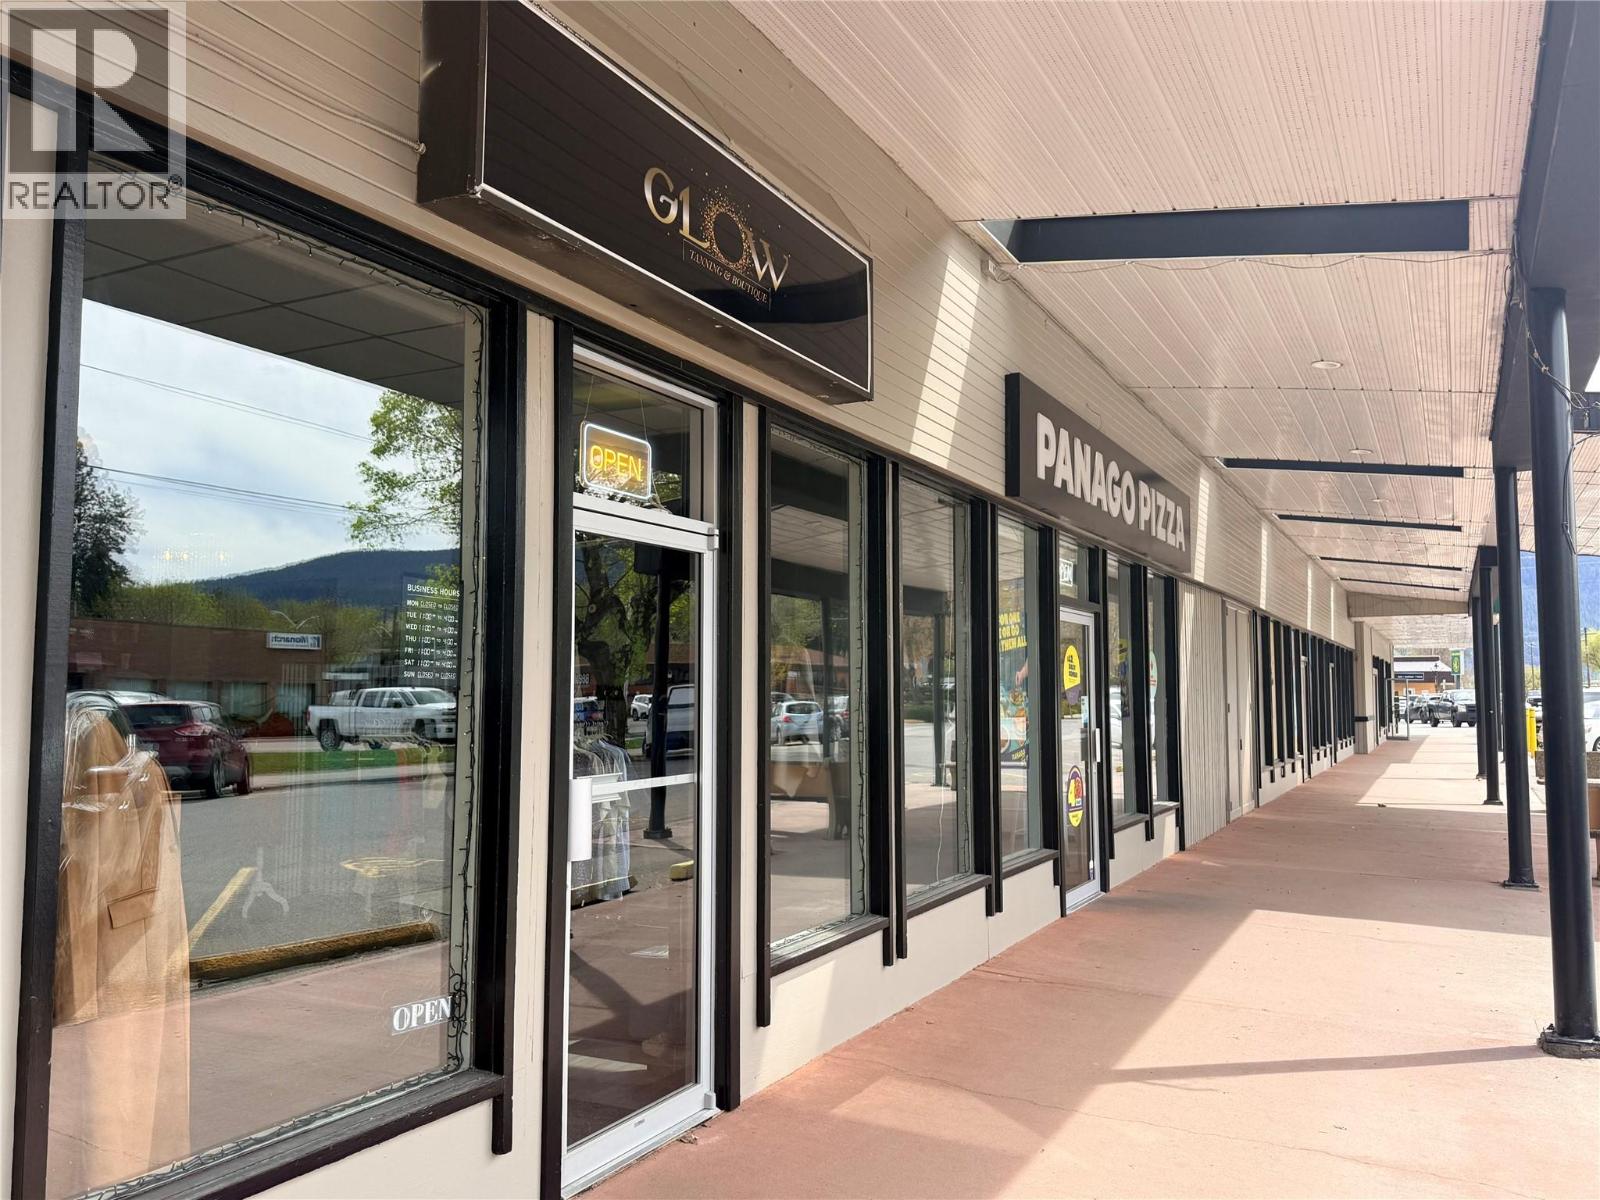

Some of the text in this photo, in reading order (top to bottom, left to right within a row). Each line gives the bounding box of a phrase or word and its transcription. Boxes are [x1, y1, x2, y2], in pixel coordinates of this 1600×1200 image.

[643, 167, 789, 292] GLOW
[690, 250, 768, 303] TANNING & BOUTIQUE
[589, 445, 642, 482] OPEN
[1037, 412, 1186, 552] PANAGO PIZZA
[407, 584, 460, 597] BUSINESS HOURS
[392, 995, 453, 1031] OPEN
